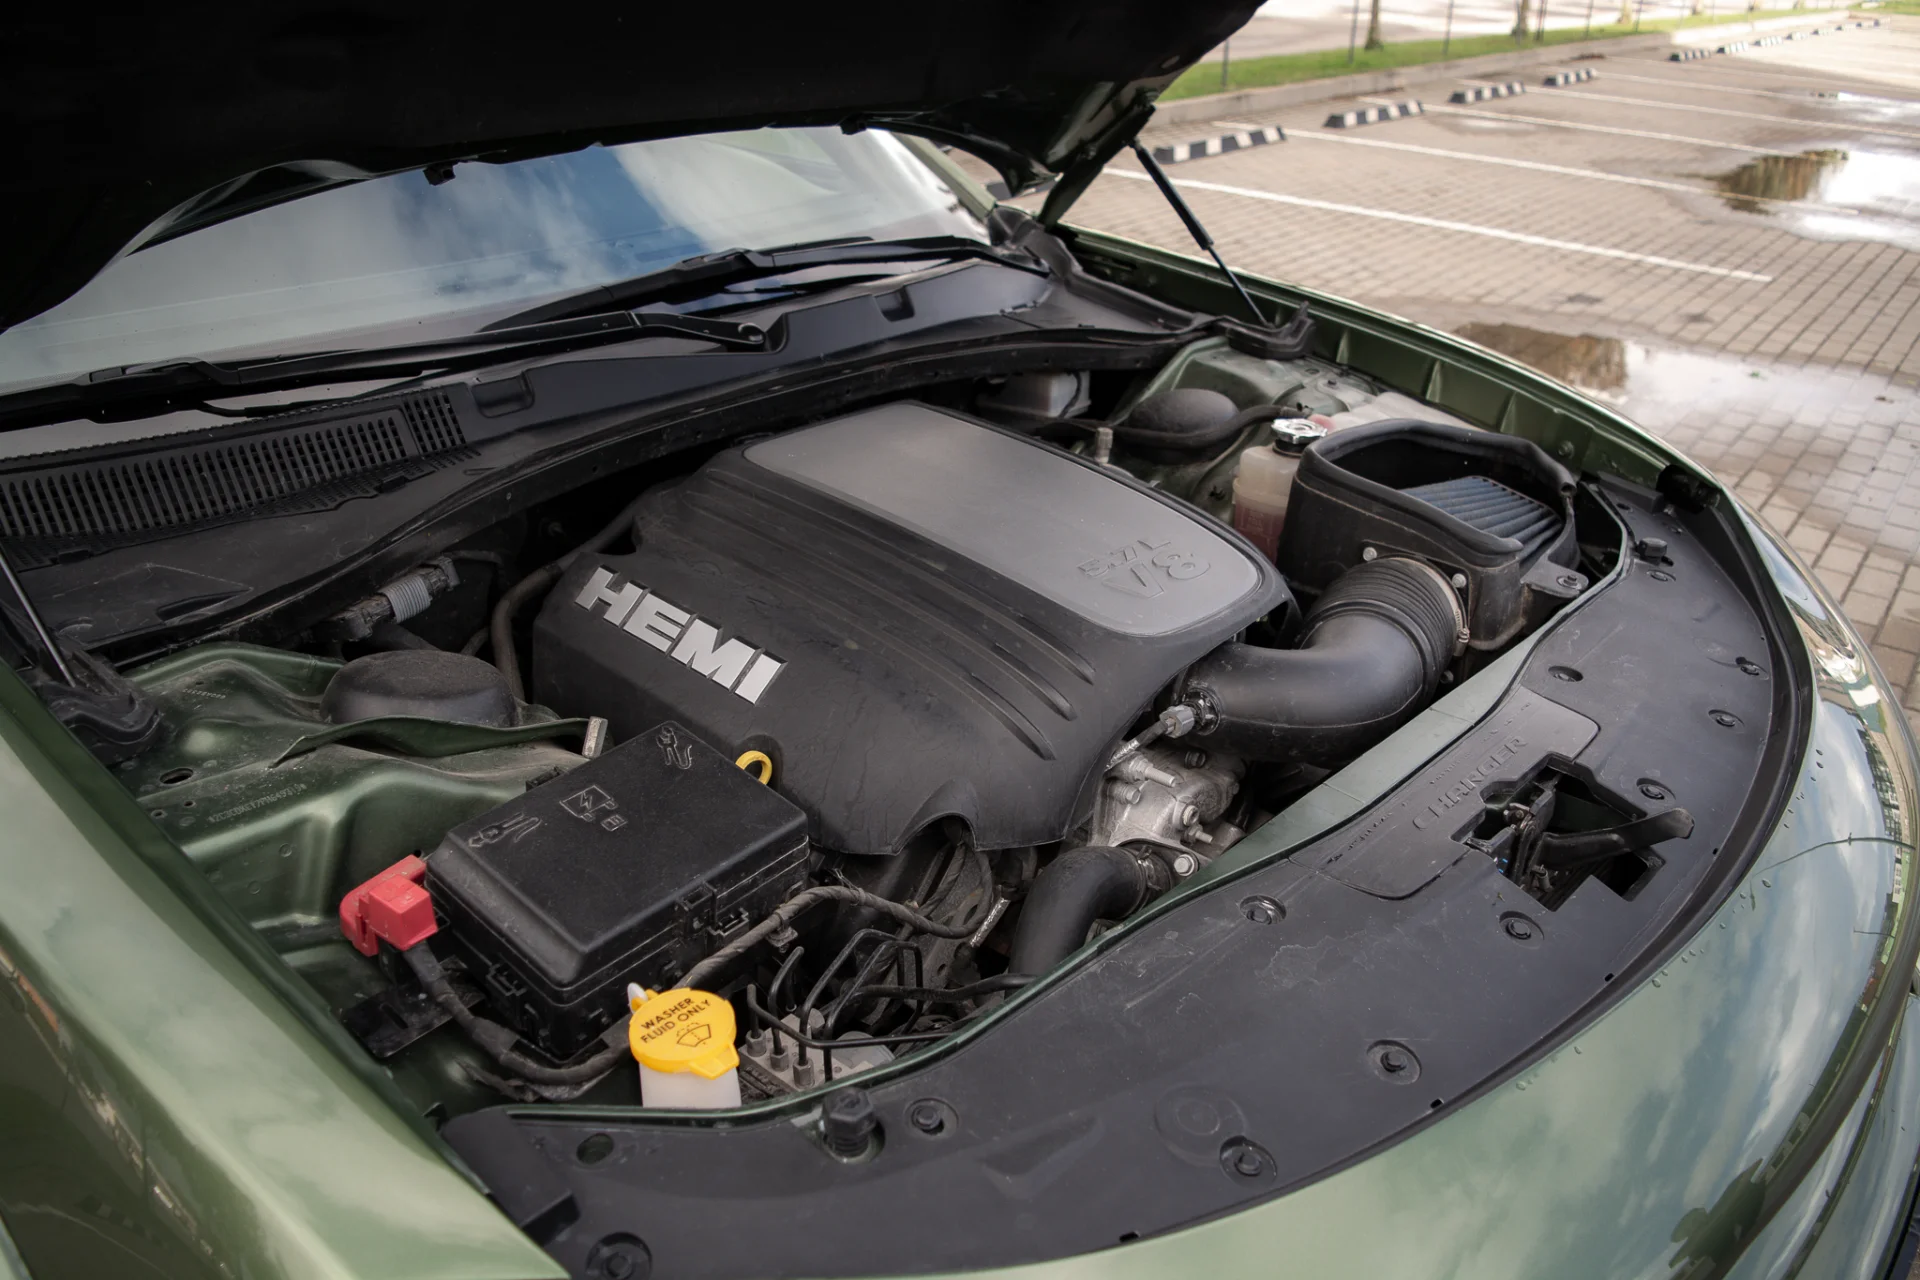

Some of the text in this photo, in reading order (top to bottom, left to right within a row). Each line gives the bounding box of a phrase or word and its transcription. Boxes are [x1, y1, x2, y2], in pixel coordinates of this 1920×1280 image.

[1077, 540, 1171, 577] 5.7L
[1102, 551, 1211, 599] V8
[575, 566, 785, 705] HEMI
[1413, 736, 1528, 831] CHARGER
[640, 999, 711, 1044] FLUID ONLY
[641, 997, 694, 1030] WASHER
